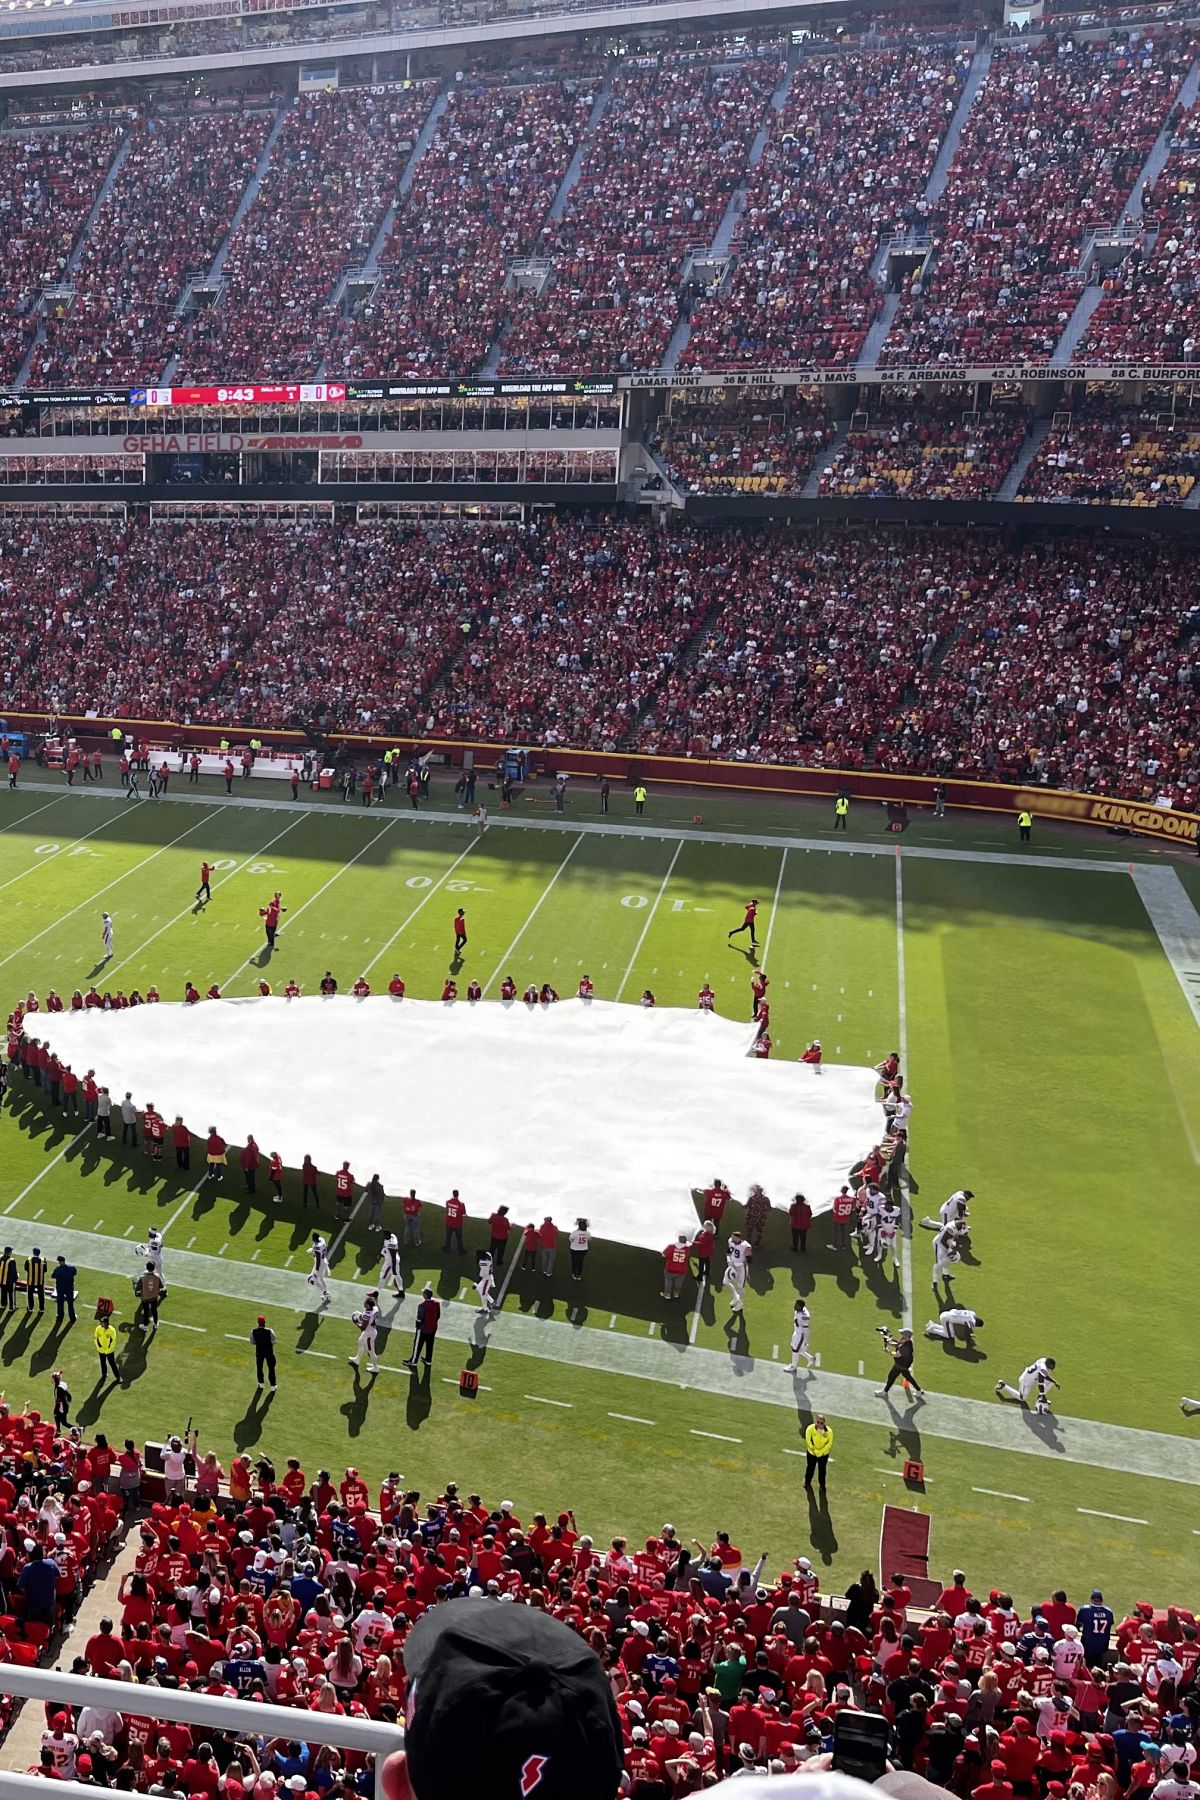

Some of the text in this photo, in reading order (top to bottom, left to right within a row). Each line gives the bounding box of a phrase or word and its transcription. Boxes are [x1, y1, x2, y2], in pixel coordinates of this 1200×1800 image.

[813, 374, 822, 383] J.
[825, 373, 856, 382] MAYS
[881, 370, 966, 381] 84 F. ARBANAS
[991, 369, 1085, 379] 42 J. ROBINSON
[1111, 370, 1125, 378] 88
[1128, 369, 1140, 378] C.
[631, 376, 701, 387] LAMAR HUNT
[737, 376, 749, 385] M.
[751, 376, 775, 384] HILL
[151, 390, 158, 403] 0
[217, 389, 254, 401] 9:43
[315, 386, 322, 399] 0
[123, 436, 181, 452] GEHA
[187, 434, 244, 453] FIELD
[258, 436, 362, 449] ARROWHEAD
[1091, 803, 1198, 839] KINGDOM
[406, 876, 476, 892] 20
[620, 894, 697, 912] 10
[337, 1177, 347, 1190] 15
[711, 1198, 722, 1207] 87
[447, 1207, 457, 1217] 15
[838, 1204, 851, 1216] 58
[578, 1237, 587, 1245] 15
[673, 1253, 686, 1263] 52
[99, 1300, 109, 1311] 20
[463, 1373, 475, 1388] 10
[908, 1464, 920, 1480] G
[24, 1486, 37, 1496] 90
[345, 1493, 363, 1508] 87
[169, 1567, 182, 1580] 15
[639, 1568, 653, 1583] 15
[251, 1584, 266, 1595] 73
[1003, 1623, 1018, 1637] 87
[1092, 1619, 1108, 1634] 17
[968, 1651, 984, 1664] 15
[1064, 1653, 1077, 1664] 17
[1140, 1655, 1156, 1665] 15
[1182, 1657, 1198, 1667] 15
[237, 1676, 253, 1690] 17
[650, 1671, 669, 1683] 14
[1032, 1681, 1050, 1693] 15
[1054, 1713, 1068, 1726] 15
